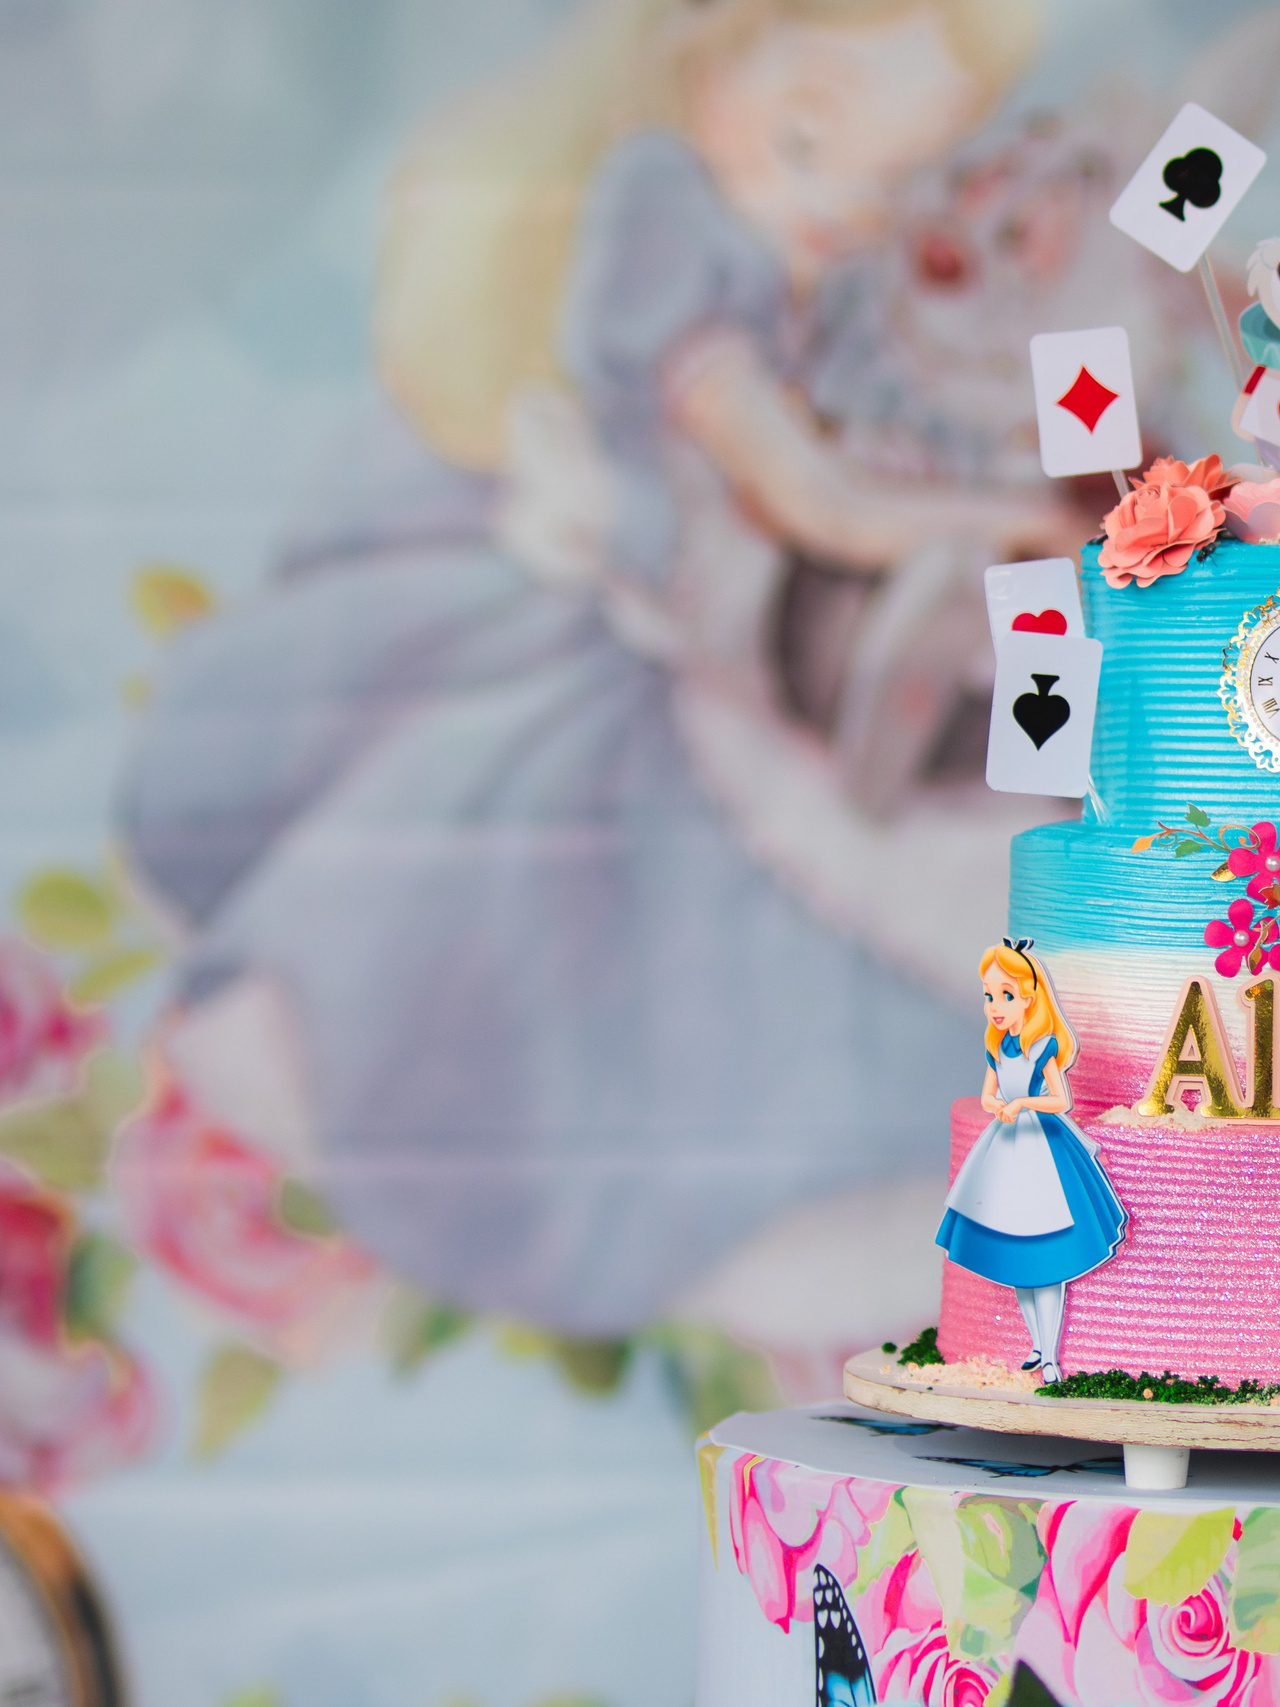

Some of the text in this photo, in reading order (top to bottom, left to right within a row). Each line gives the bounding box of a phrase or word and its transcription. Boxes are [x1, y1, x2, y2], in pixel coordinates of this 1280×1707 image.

[1264, 652, 1279, 664] X
[1258, 676, 1273, 686] IX
[1261, 698, 1280, 719] VIII
